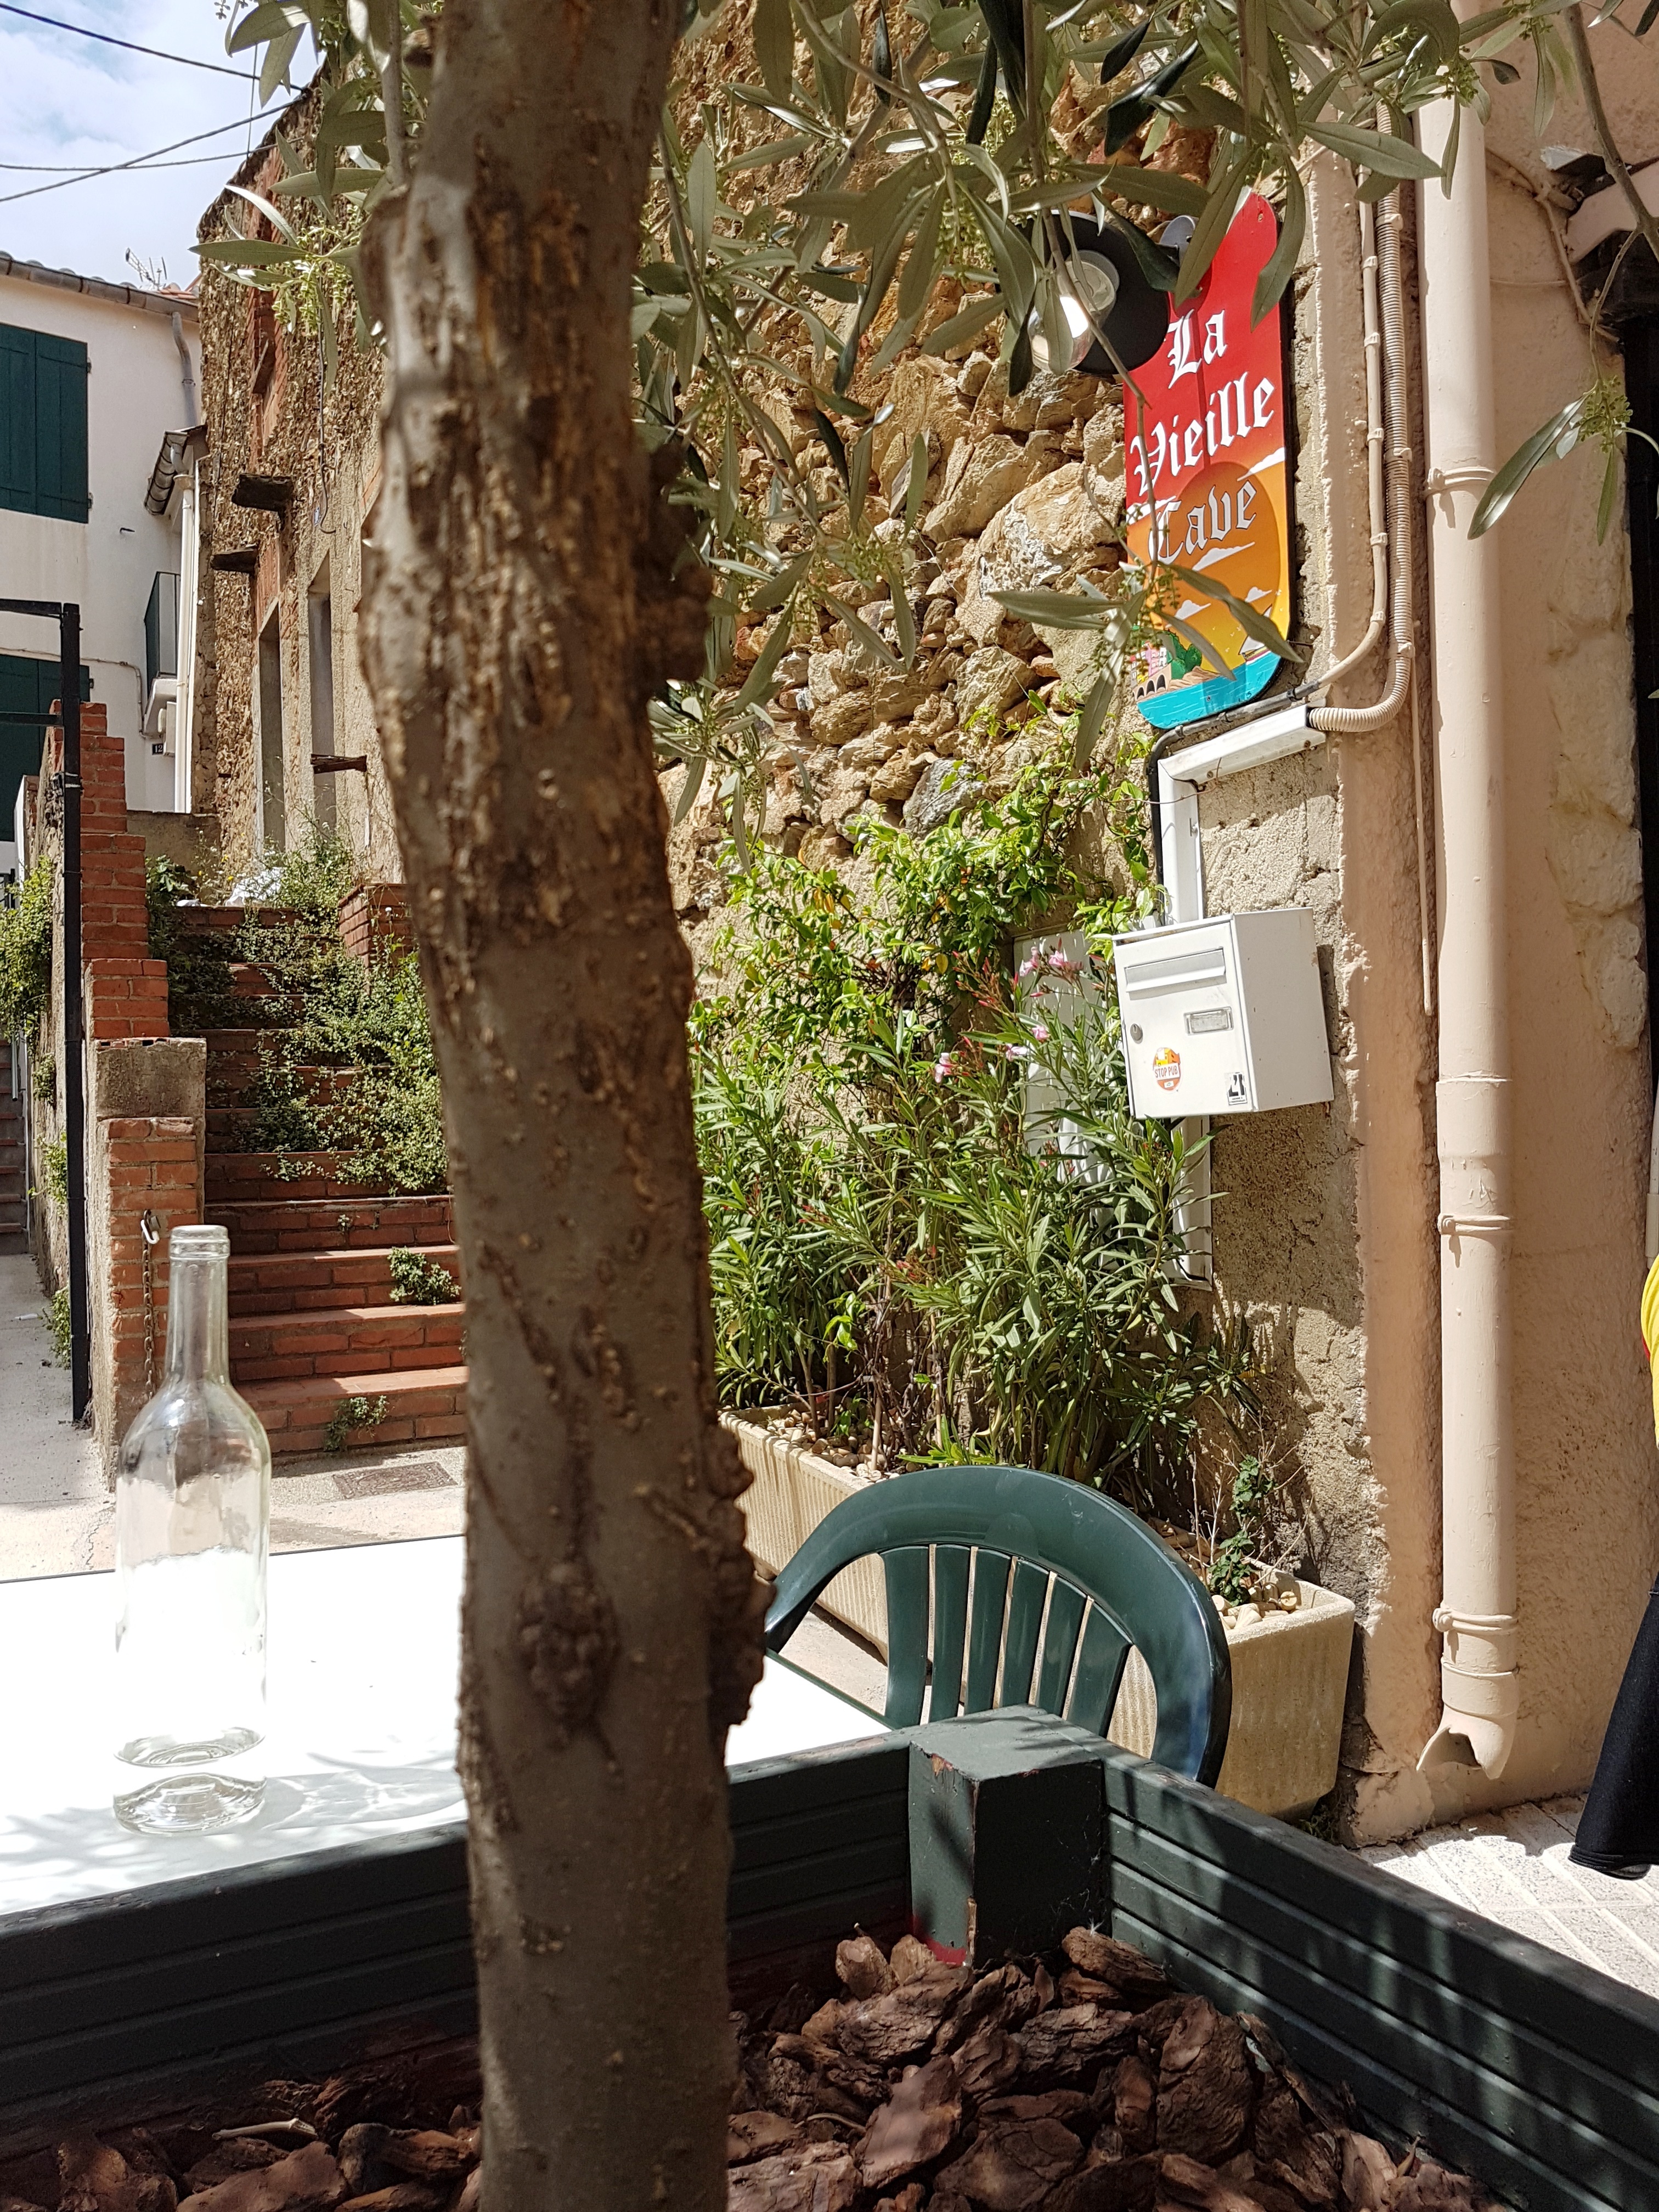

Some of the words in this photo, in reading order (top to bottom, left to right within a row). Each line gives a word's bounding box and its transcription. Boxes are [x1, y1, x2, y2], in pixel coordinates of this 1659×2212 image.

[1164, 308, 1228, 389] La
[1130, 371, 1275, 496] Vieille
[1148, 479, 1257, 565] Cave
[155, 744, 163, 753] 12
[1154, 1066, 1167, 1079] STOP
[1168, 1065, 1178, 1076] PUB
